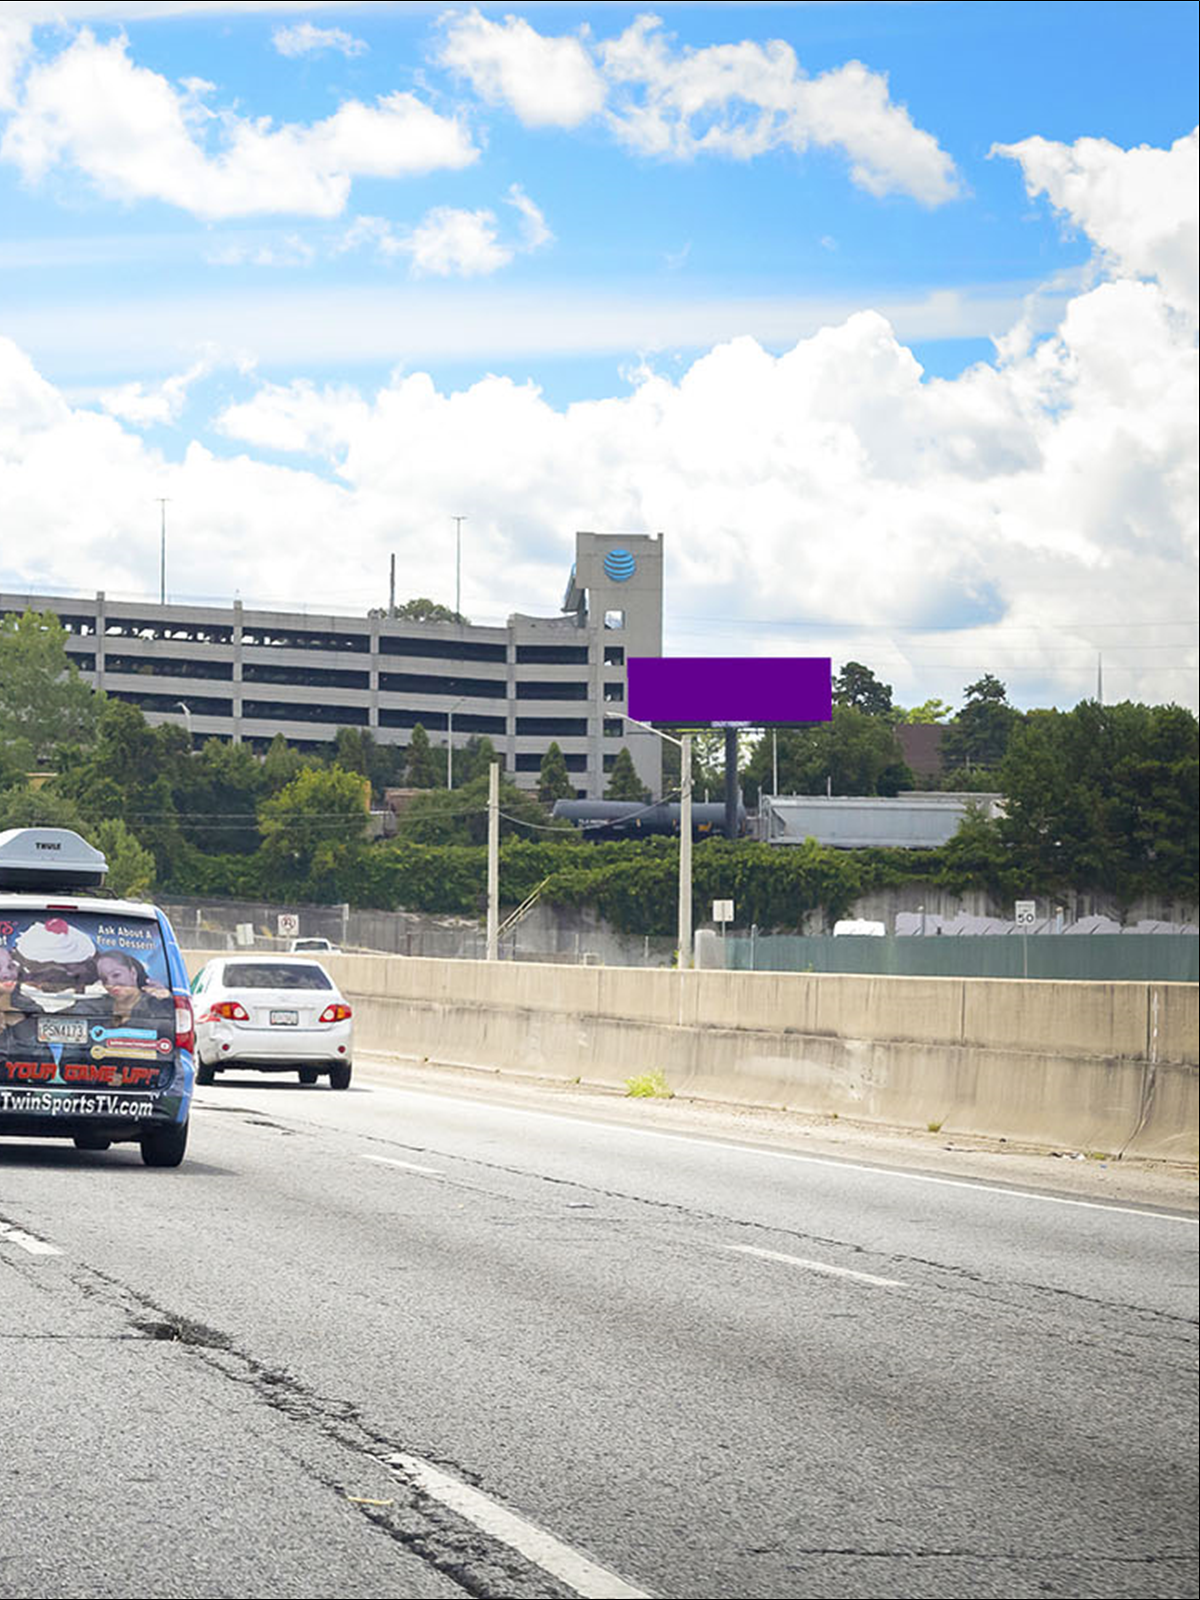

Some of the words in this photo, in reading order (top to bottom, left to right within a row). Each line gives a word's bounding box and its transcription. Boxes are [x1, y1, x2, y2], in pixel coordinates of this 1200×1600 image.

[1018, 913, 1035, 923] 50
[98, 924, 115, 935] Ask
[118, 926, 144, 938] About
[5, 1061, 58, 1080] YOUR
[64, 1064, 116, 1083] GAME
